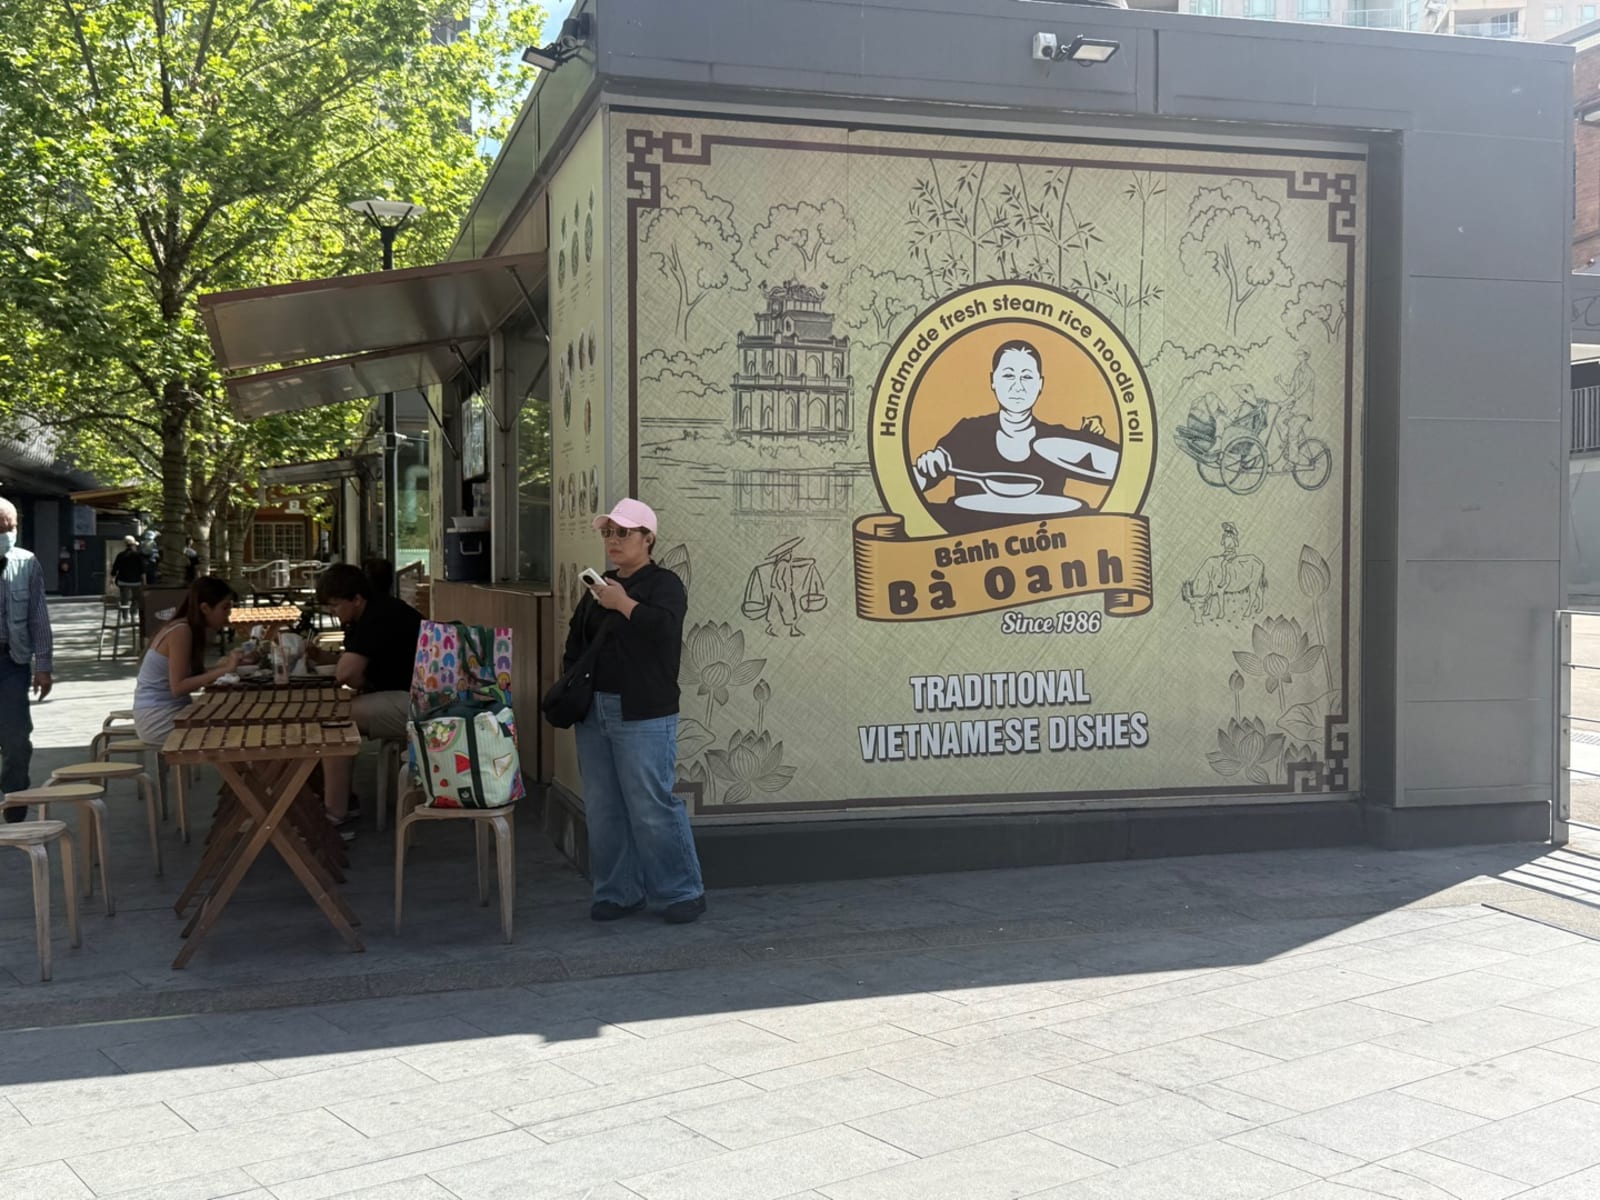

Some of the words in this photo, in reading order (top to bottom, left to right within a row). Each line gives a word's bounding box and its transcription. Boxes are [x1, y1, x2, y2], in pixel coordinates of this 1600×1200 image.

[880, 325, 939, 437] Handmade
[939, 298, 988, 332] fresh
[993, 294, 1054, 318] steam
[1058, 309, 1093, 339] rice
[1093, 337, 1136, 404] noodle
[1127, 409, 1144, 443] roll
[934, 538, 999, 568] Bánh
[1004, 521, 1067, 556] Cuốn
[887, 570, 957, 615] Bà
[984, 549, 1124, 601] Oanh
[1001, 612, 1055, 634] Since
[1055, 612, 1102, 633] 1986
[909, 668, 1092, 711] TRADITIONAL
[857, 716, 1041, 762] VIETNAMESE
[1048, 711, 1149, 751] DISHES
